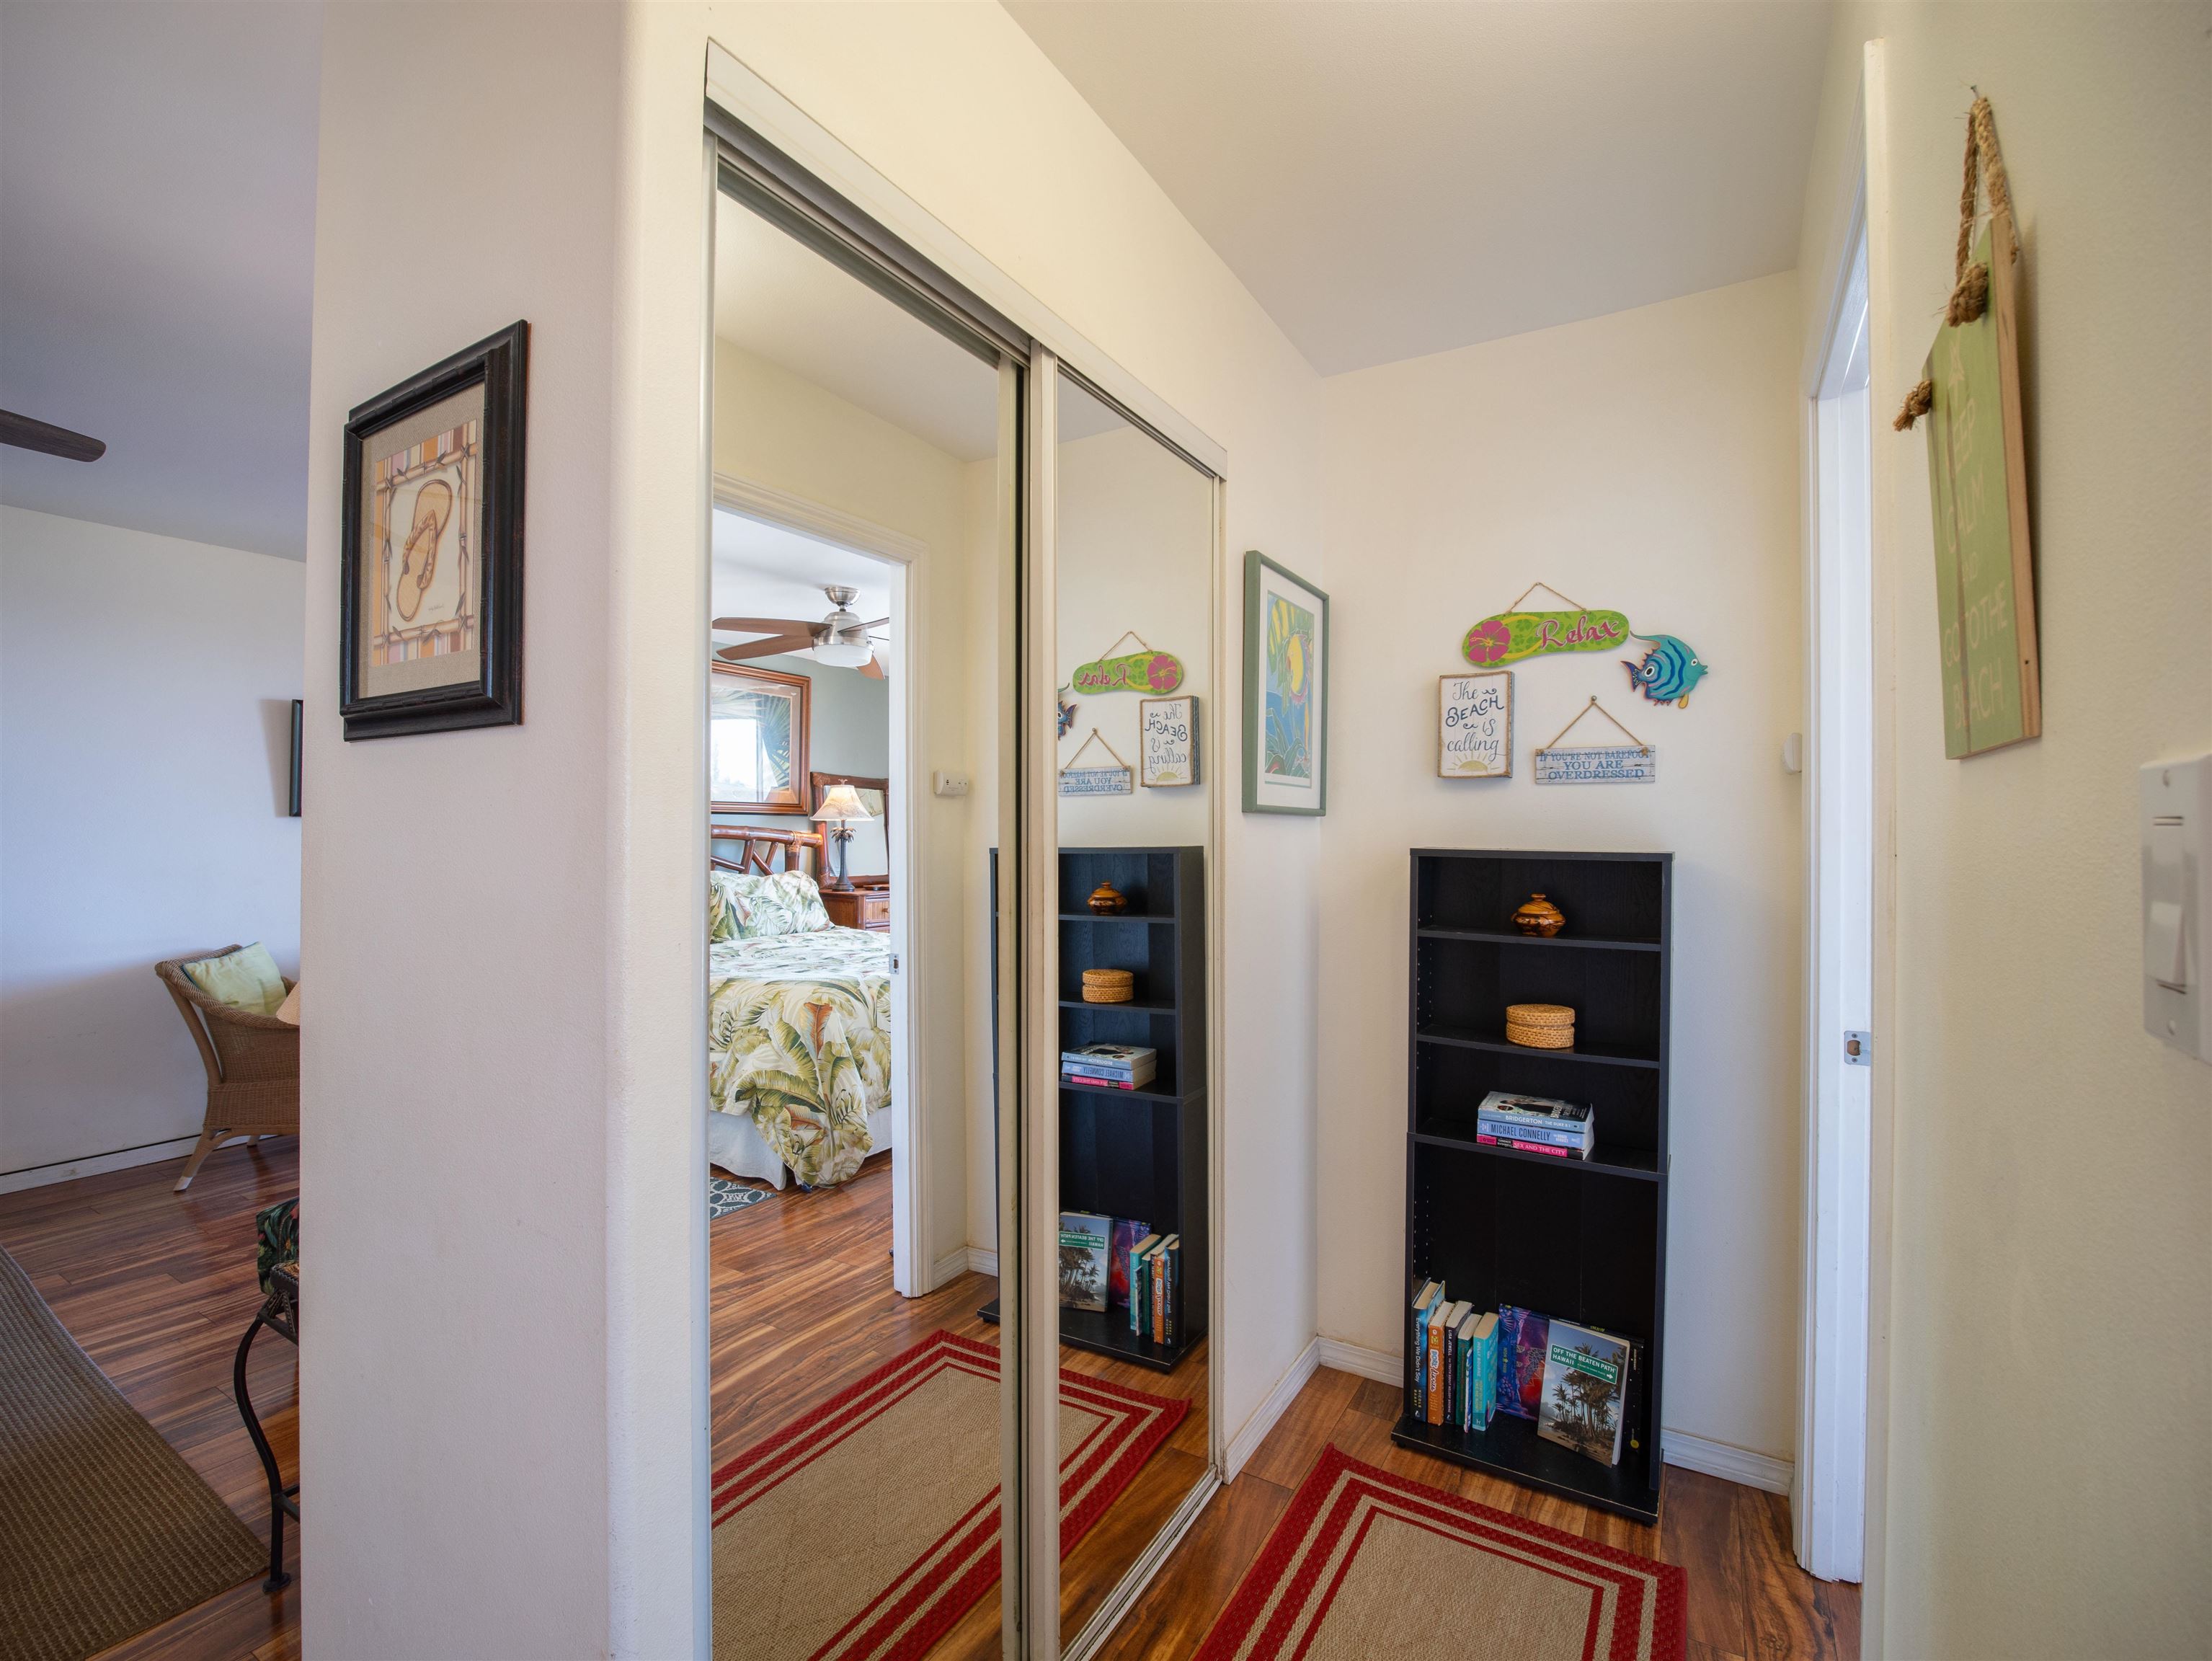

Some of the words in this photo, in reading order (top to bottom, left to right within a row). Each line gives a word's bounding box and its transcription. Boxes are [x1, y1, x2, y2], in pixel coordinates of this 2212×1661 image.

[1536, 615, 1620, 650] Relax
[1452, 681, 1479, 701] The
[1446, 695, 1504, 727] BEACH
[1483, 718, 1496, 736] is
[1447, 732, 1506, 762] calling
[1551, 752, 1581, 761] YOU'RE
[1584, 751, 1602, 761] NOT
[1563, 761, 1591, 770] YOU
[1596, 761, 1623, 769] ARE
[1548, 769, 1644, 779] OVERDRESSED
[1505, 1115, 1542, 1125] BRIDGERTON
[1491, 1125, 1516, 1137] MICHAEL
[1519, 1128, 1550, 1141] CONNELLY
[1415, 1346, 1421, 1355] We
[1553, 1354, 1575, 1365] HAWAII
[1578, 1355, 1600, 1368] BEATEN
[1600, 1363, 1615, 1373] PATH
